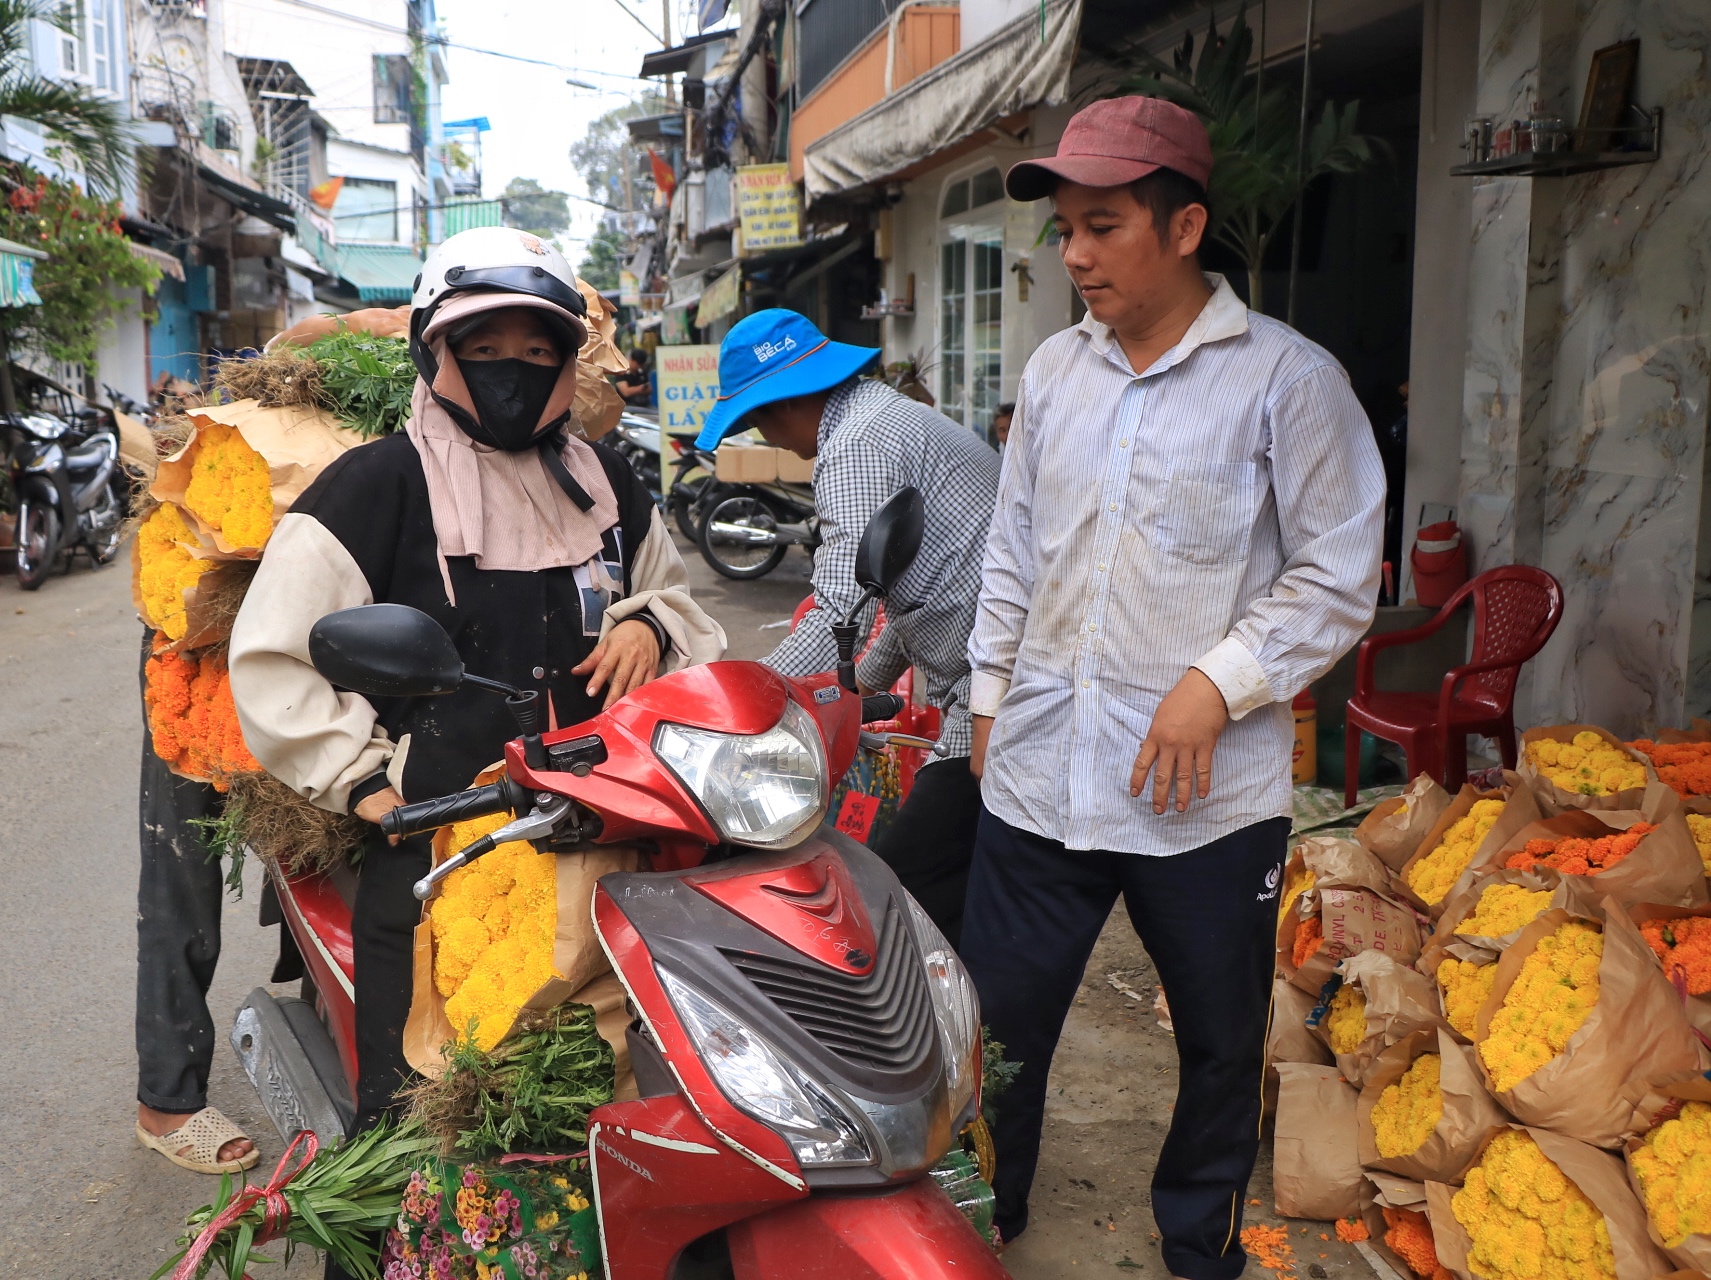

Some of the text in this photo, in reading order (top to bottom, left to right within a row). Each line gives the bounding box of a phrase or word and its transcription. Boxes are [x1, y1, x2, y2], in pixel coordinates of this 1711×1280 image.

[664, 354, 693, 374] NHẬN
[665, 382, 720, 403] GIẶT
[596, 1137, 655, 1182] HONDA
